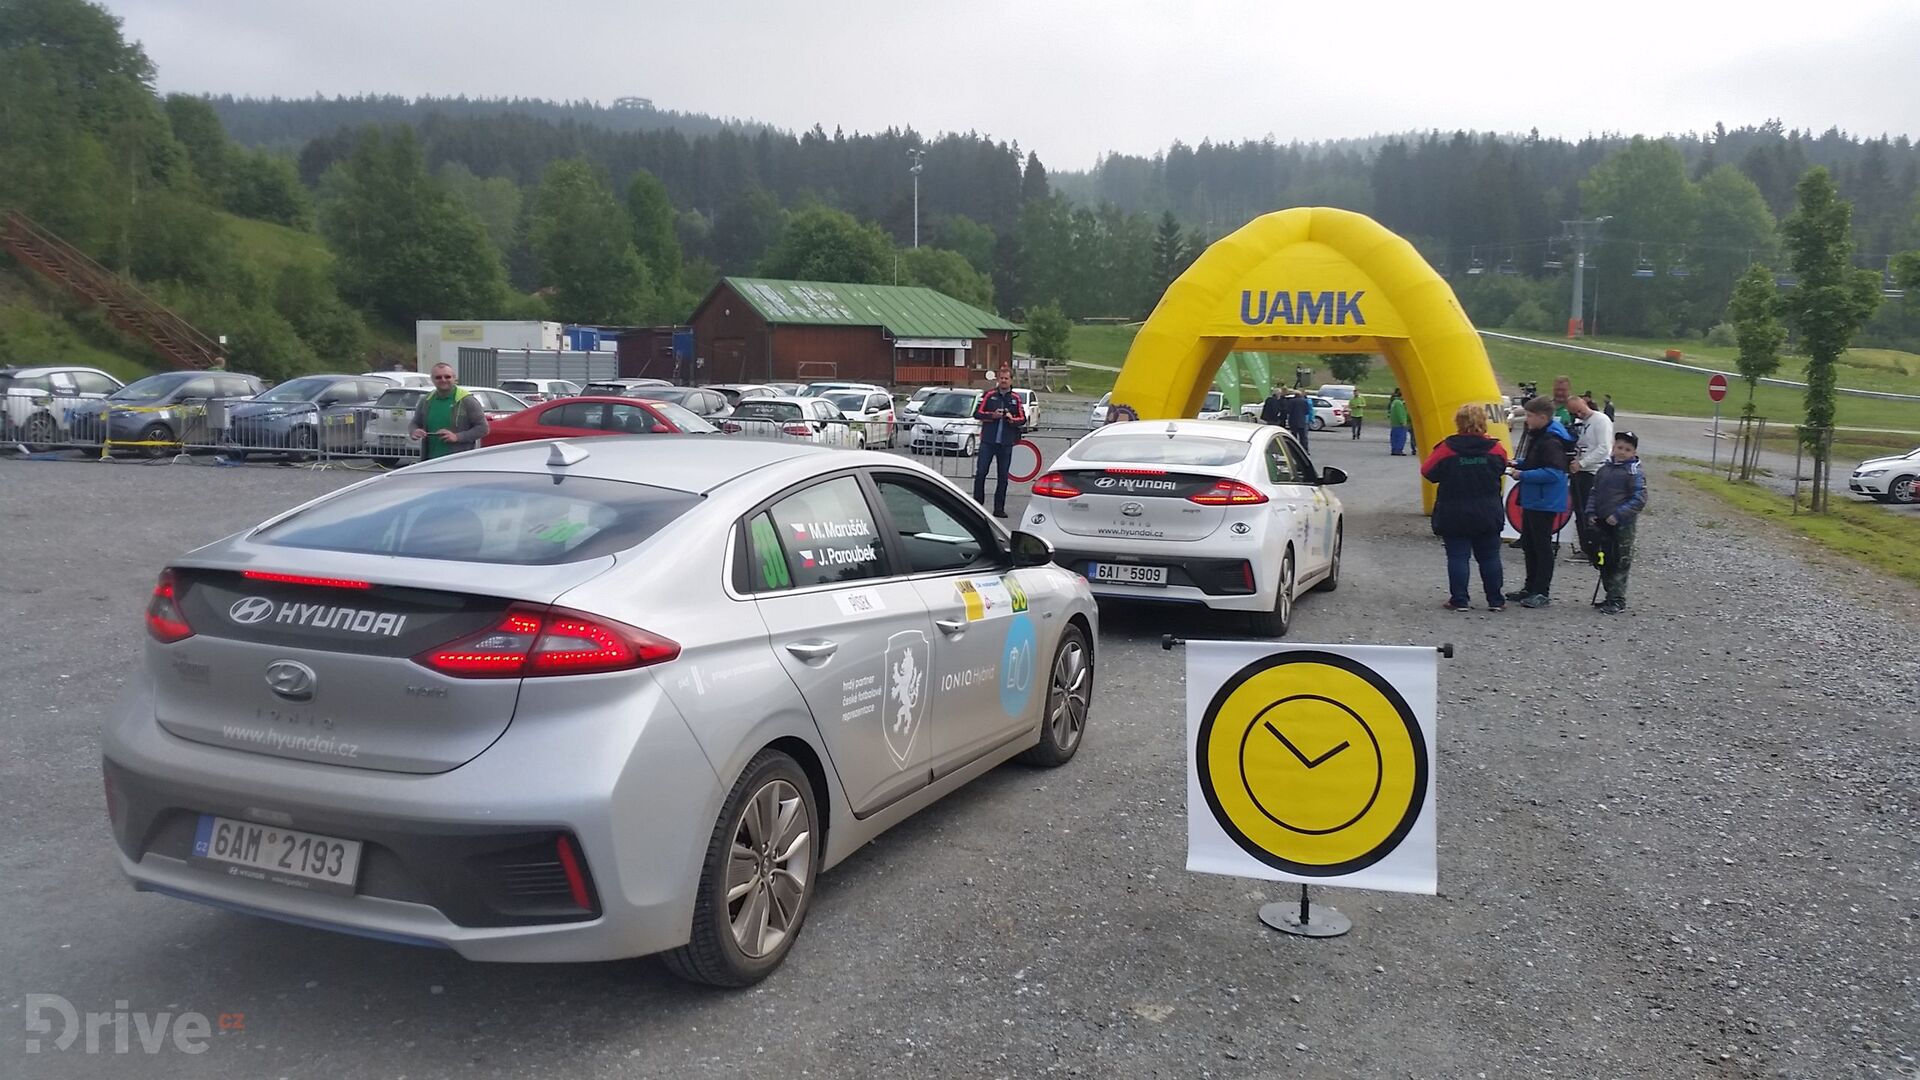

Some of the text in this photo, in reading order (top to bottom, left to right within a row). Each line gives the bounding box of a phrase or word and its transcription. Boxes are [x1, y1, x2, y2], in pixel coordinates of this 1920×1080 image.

[1240, 290, 1366, 325] UAMK
[1119, 479, 1176, 490] HYUNDAI
[1097, 528, 1164, 537] www.hyundai.cz
[827, 544, 877, 564] Paroubek
[1130, 567, 1161, 581] 5909
[276, 602, 407, 637] HYUNDAI
[941, 669, 972, 691] IONIQ
[223, 723, 359, 758] www.hyundai.cz
[214, 823, 345, 877] 6AM 2193
